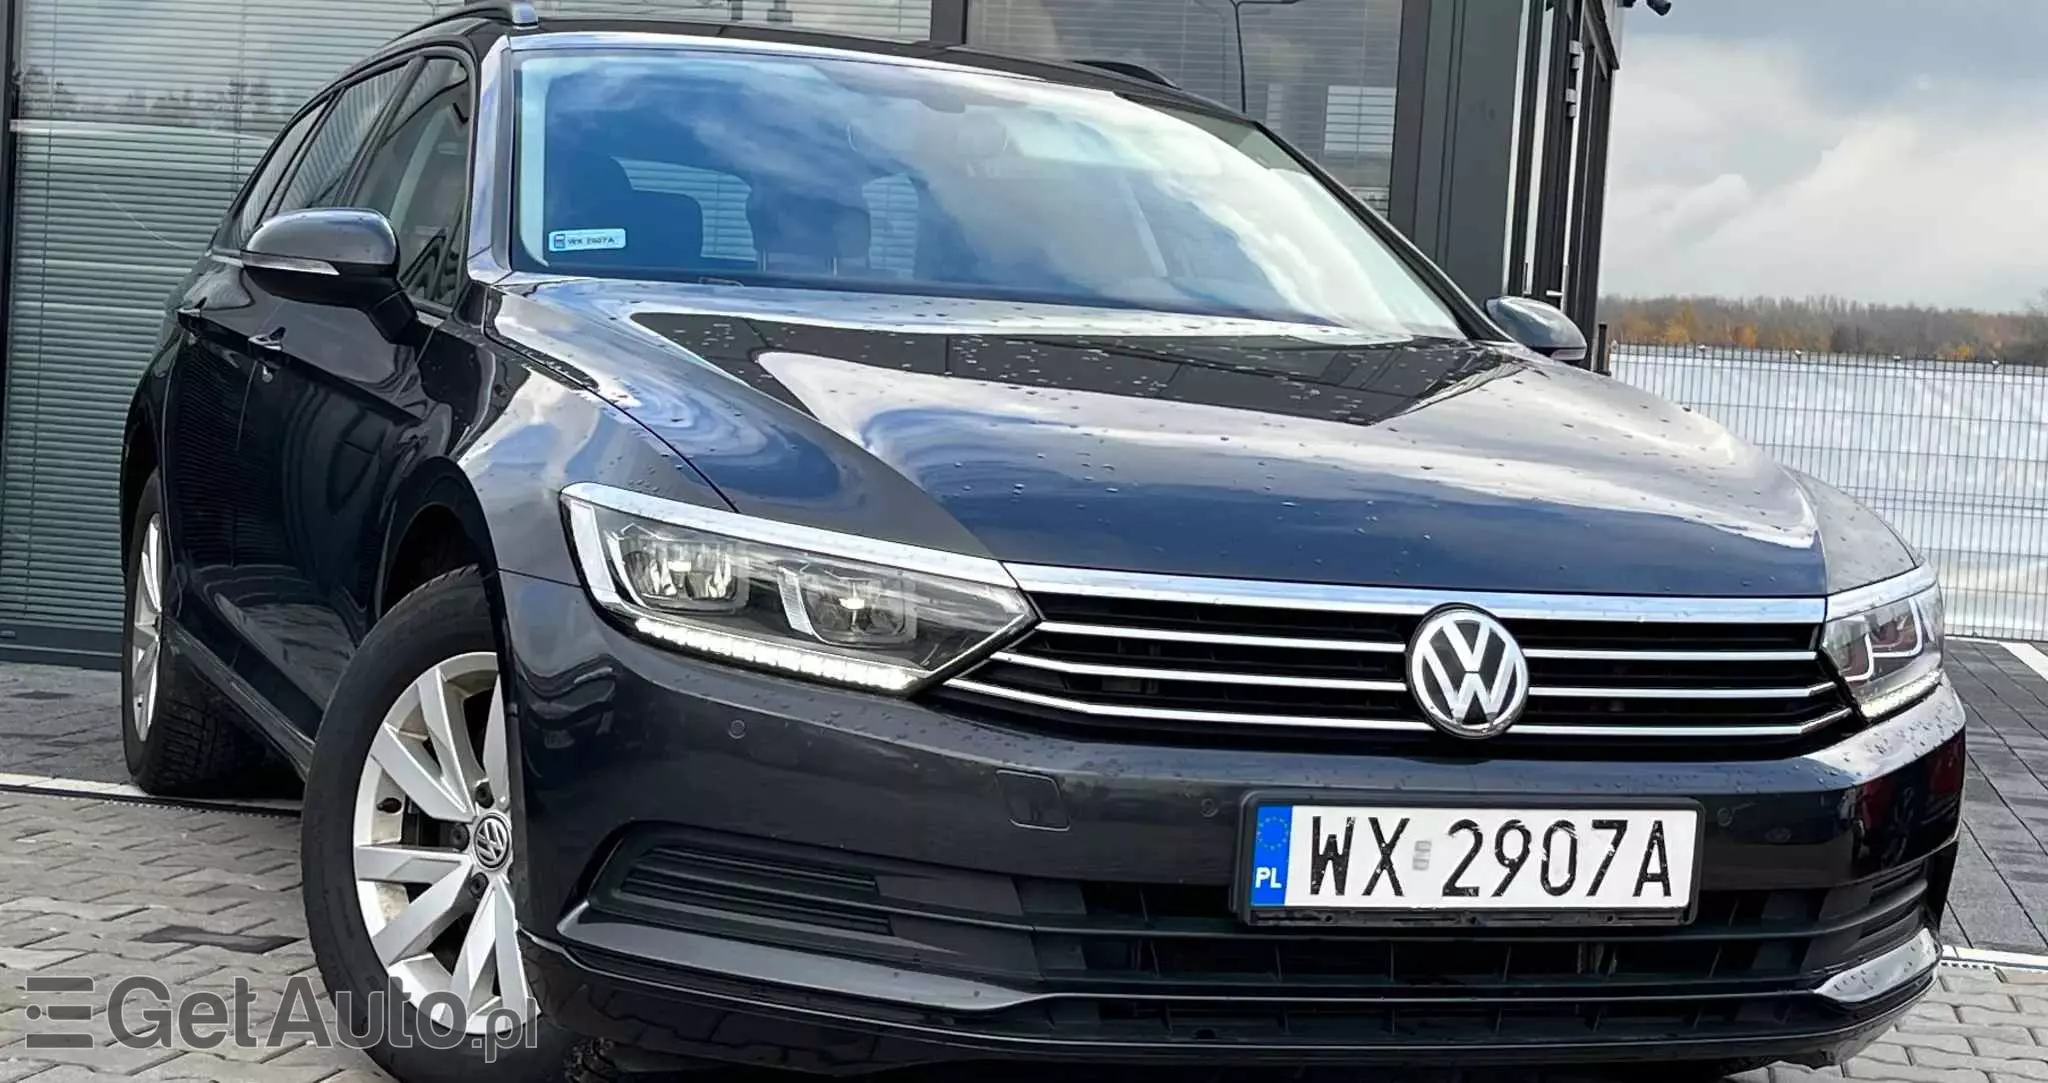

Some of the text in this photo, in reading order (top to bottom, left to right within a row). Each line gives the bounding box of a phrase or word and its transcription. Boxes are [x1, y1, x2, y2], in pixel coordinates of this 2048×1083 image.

[1255, 867, 1282, 890] PL
[1310, 816, 1672, 897] WX 2907A
